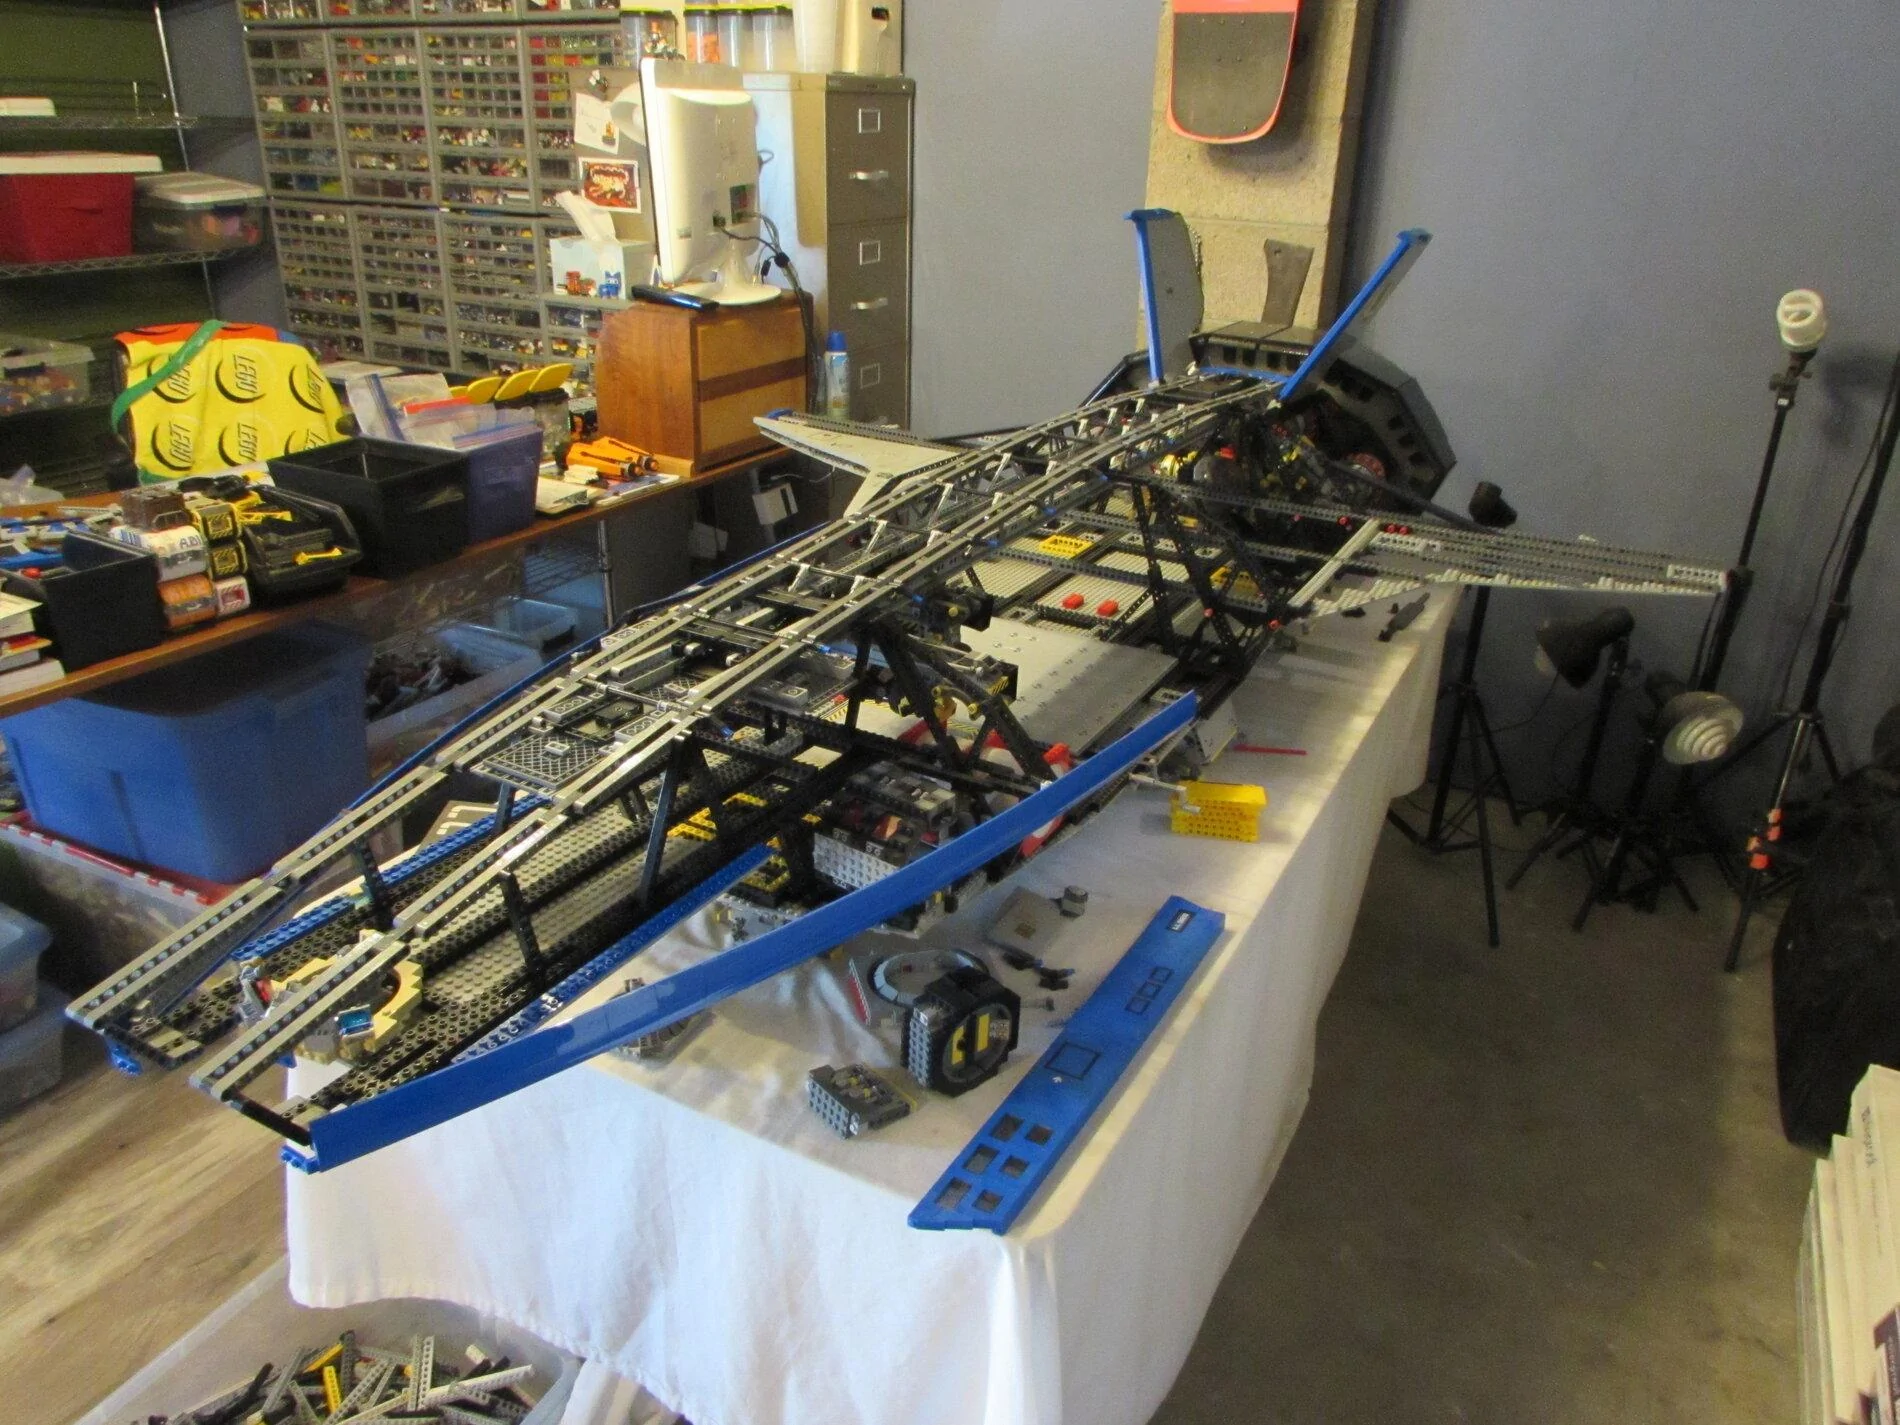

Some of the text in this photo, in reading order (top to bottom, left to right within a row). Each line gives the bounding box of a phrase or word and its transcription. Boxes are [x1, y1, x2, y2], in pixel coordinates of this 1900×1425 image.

[233, 354, 258, 393] LEGO
[169, 421, 192, 464] LEGO
[237, 423, 258, 462] LEGO
